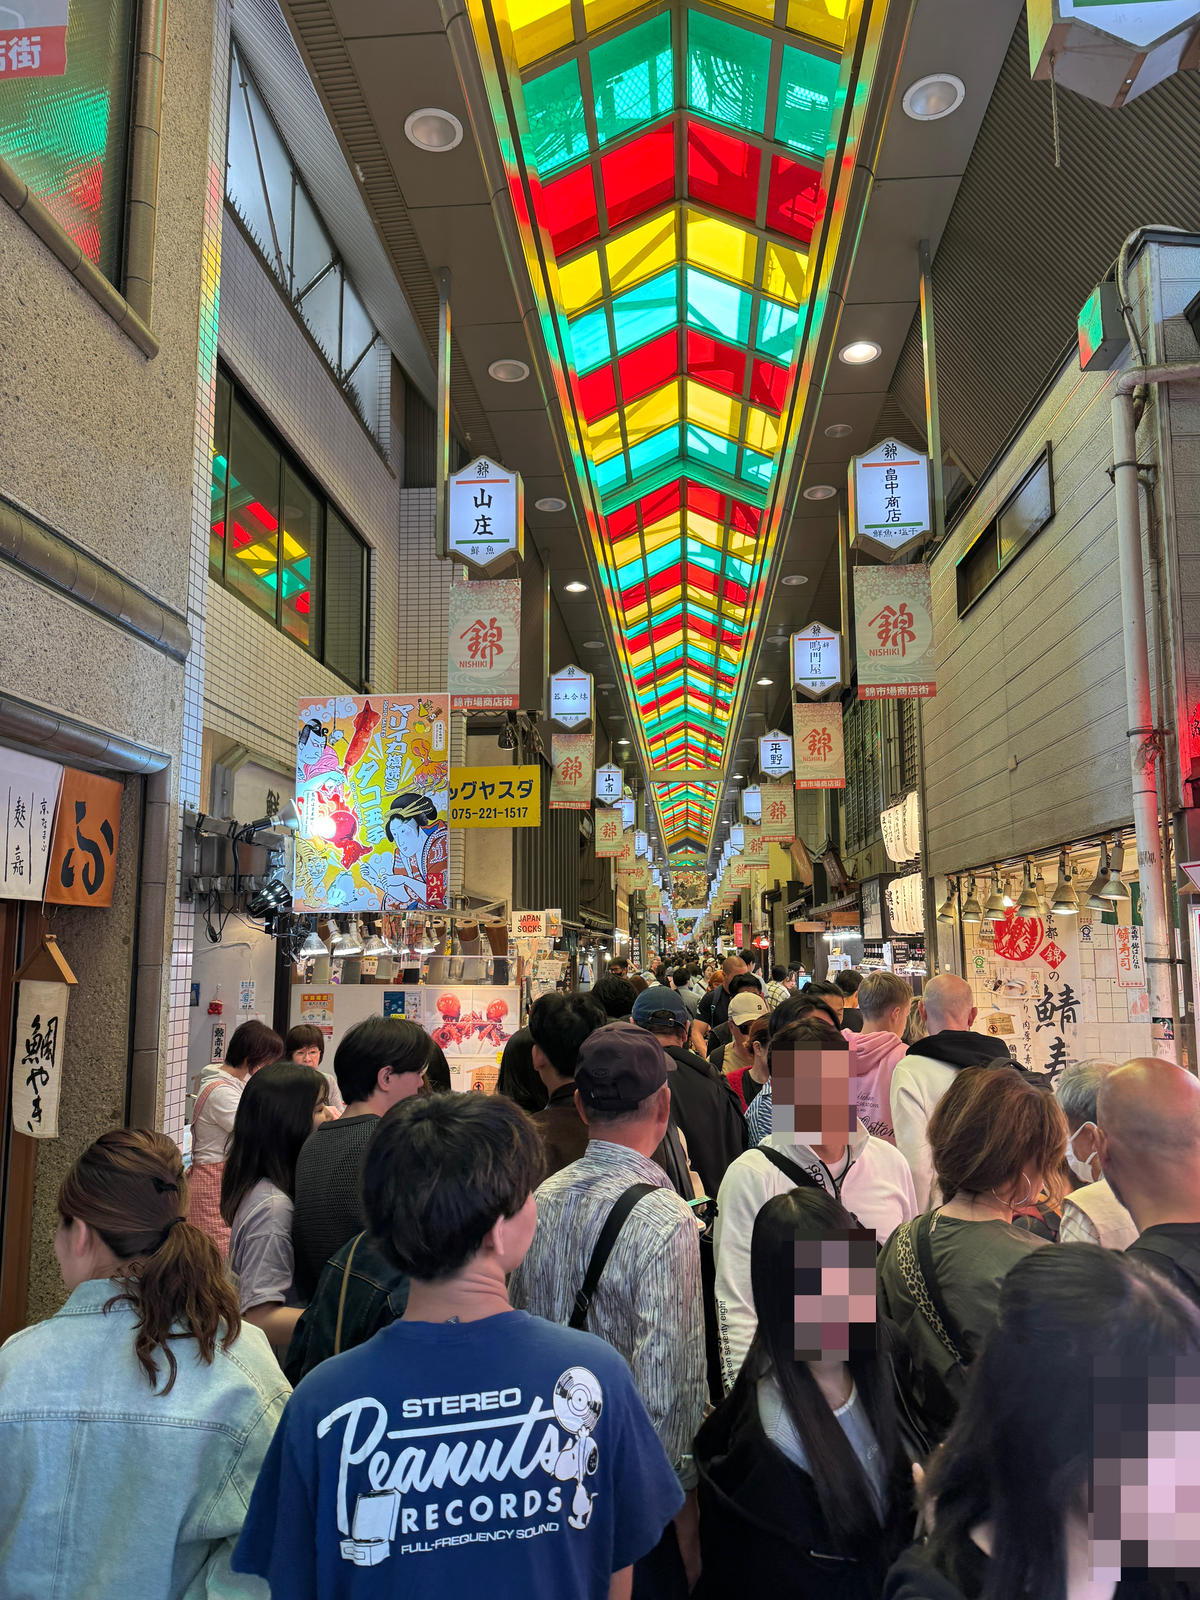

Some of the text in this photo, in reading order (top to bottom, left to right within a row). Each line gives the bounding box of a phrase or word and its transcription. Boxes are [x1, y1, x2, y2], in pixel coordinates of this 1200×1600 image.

[0, 36, 41, 71] 街
[884, 467, 902, 523] 畠中商店
[472, 487, 494, 536] 山庄
[459, 617, 504, 670] 錦
[868, 602, 917, 658] 錦
[459, 661, 488, 669] NISHIKI
[869, 647, 900, 657] NISHIKI
[453, 694, 513, 707] 錦市場商店街
[864, 685, 929, 698] 錦市場商店街
[770, 743, 783, 765] 平野
[802, 727, 833, 763] 錦
[557, 756, 583, 787] 錦
[451, 806, 529, 820] 075-221-1517
[766, 801, 787, 825] 錦
[61, 801, 114, 895] ふ
[517, 925, 543, 933] SOCKS
[518, 914, 541, 923] JAPAN
[402, 1387, 522, 1419] STEREO
[317, 1396, 572, 1536] Peanuts
[401, 1486, 563, 1534] RECORDS
[401, 1521, 560, 1555] FULL-FREQUENCY SOUND
